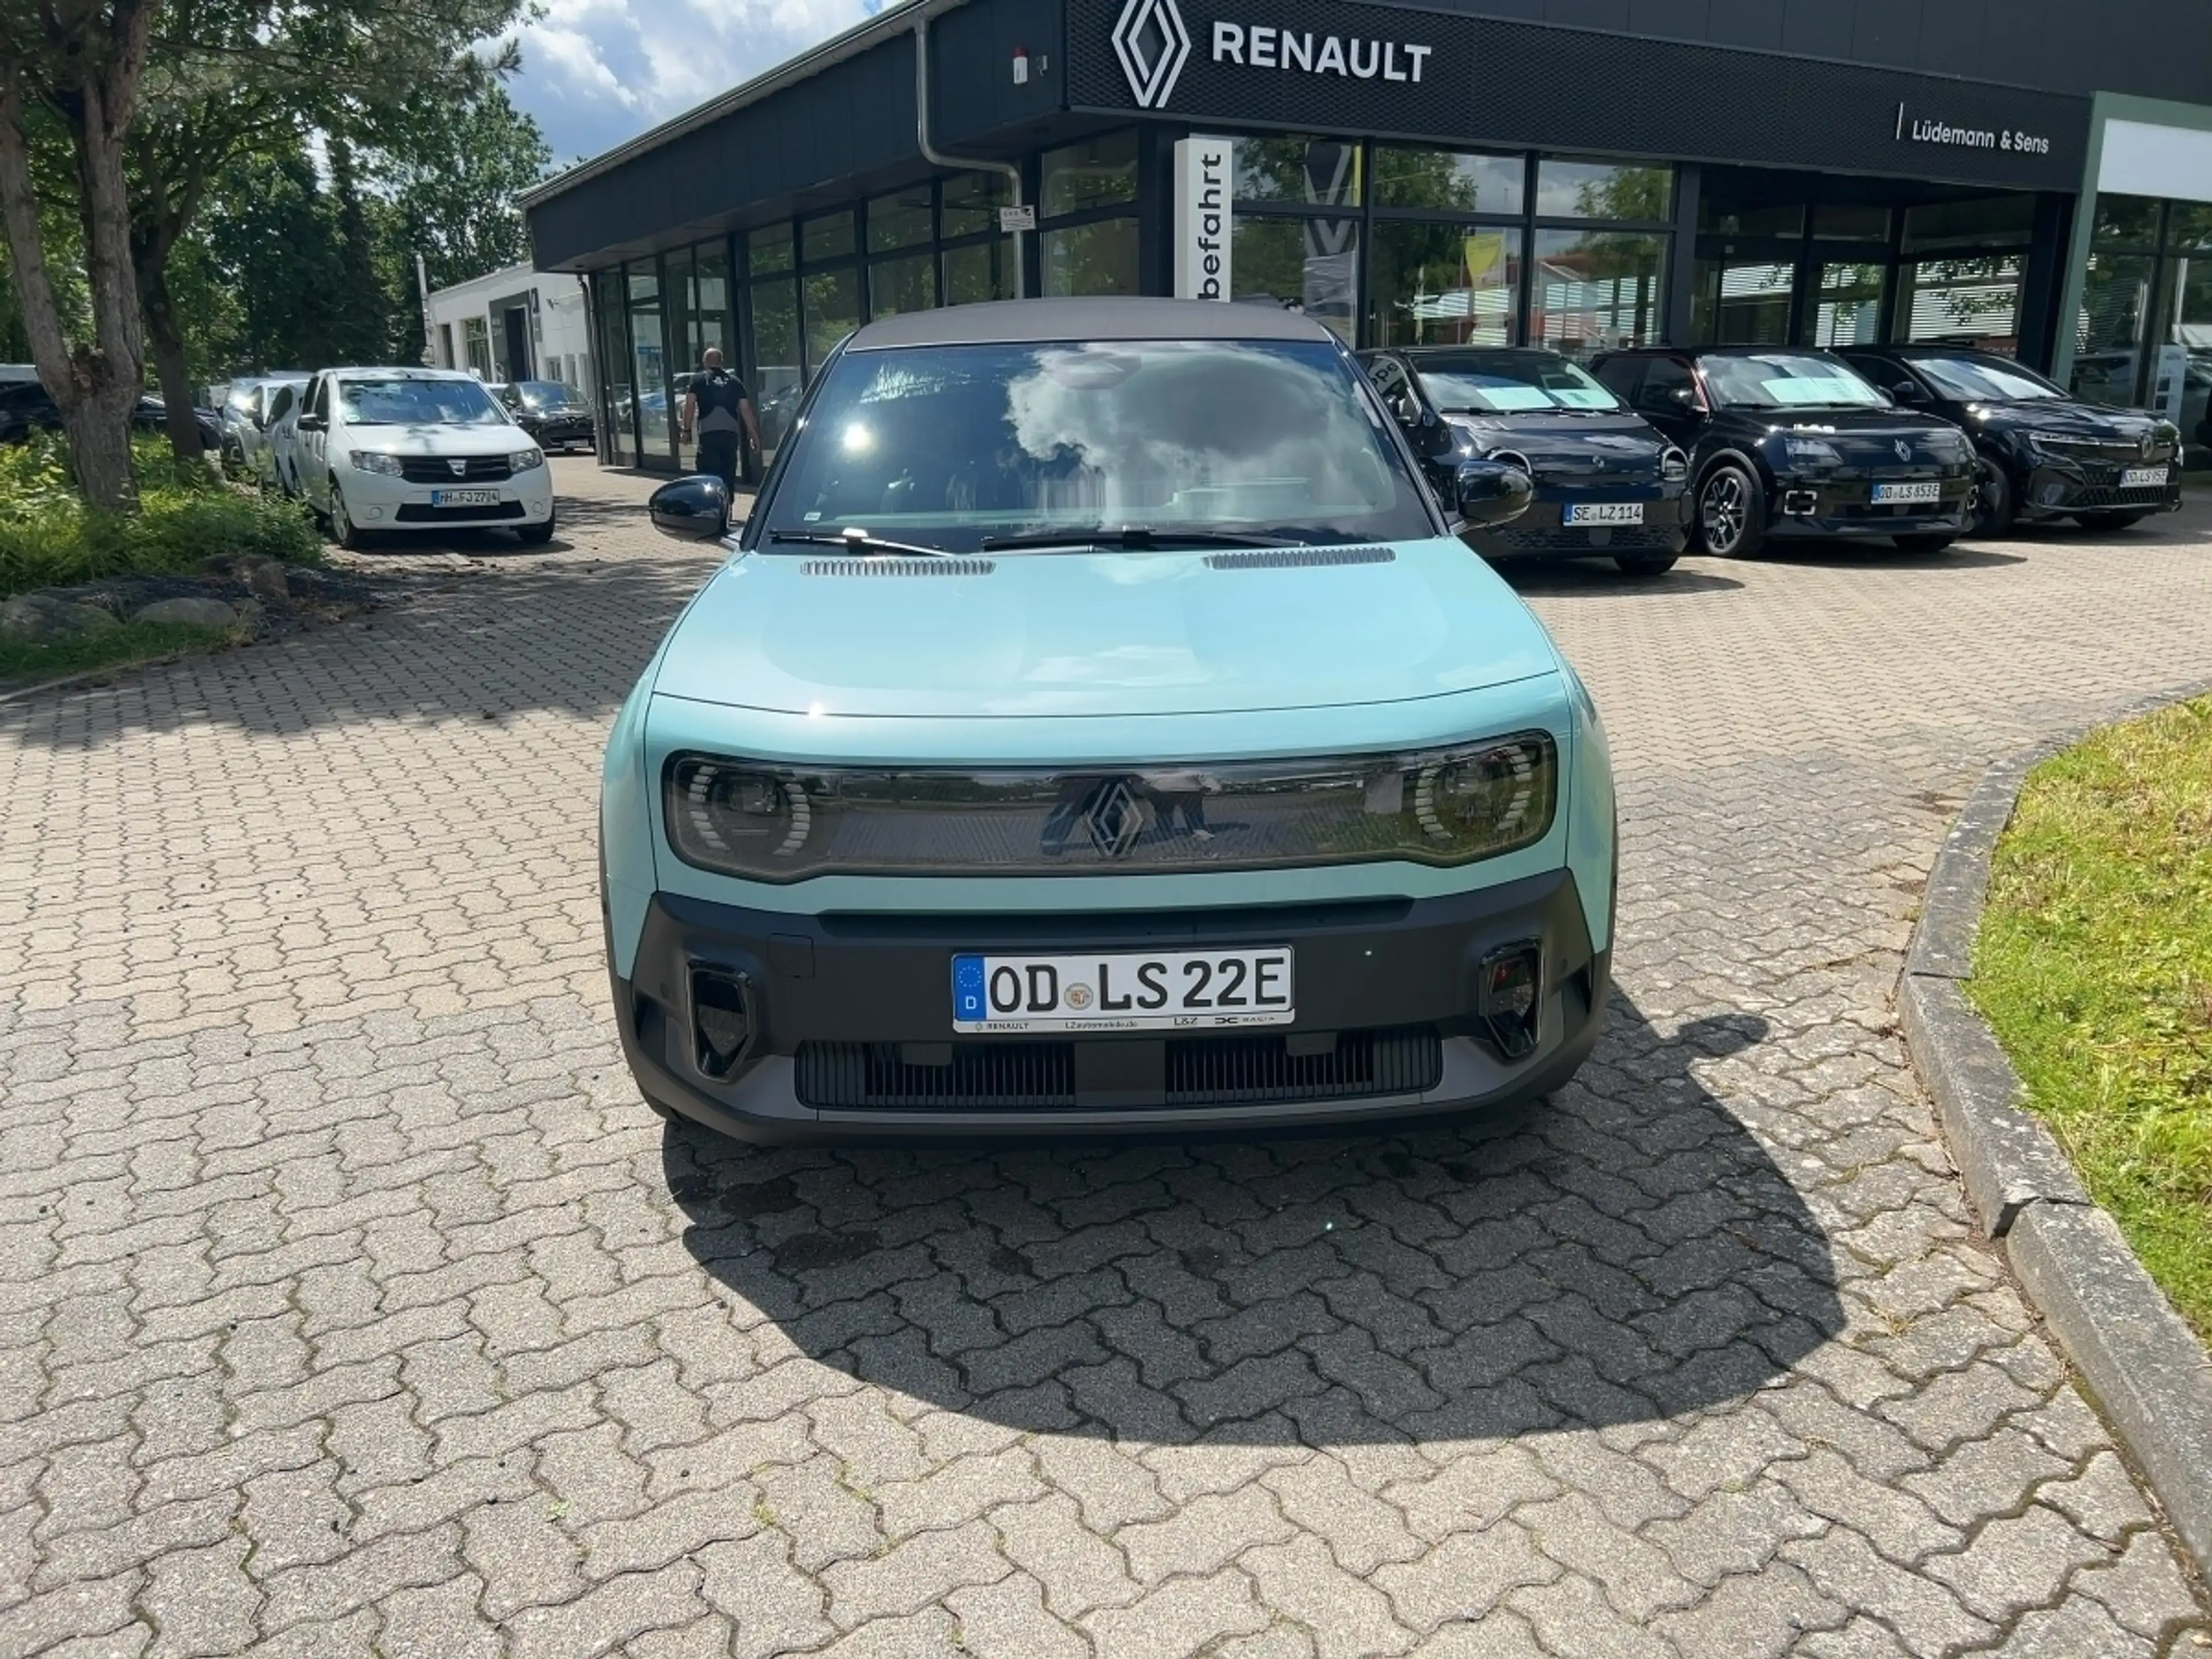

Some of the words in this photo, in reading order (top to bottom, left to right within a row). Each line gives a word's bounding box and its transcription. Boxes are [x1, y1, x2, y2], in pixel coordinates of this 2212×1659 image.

[1213, 21, 1431, 82] RENAULT
[1912, 119, 1996, 148] Lüdemann
[1999, 130, 2012, 150] &
[2014, 131, 2050, 154] Sens
[1198, 153, 1221, 300] befahrt
[1574, 507, 1590, 521] SE
[1599, 506, 1615, 520] LZ
[1618, 505, 1641, 520] 114
[965, 996, 977, 1010] D
[990, 964, 1059, 1013] OD
[1099, 961, 1168, 1011] LS
[1183, 957, 1287, 1008] 22E
[1174, 1017, 1198, 1026] L&Z
